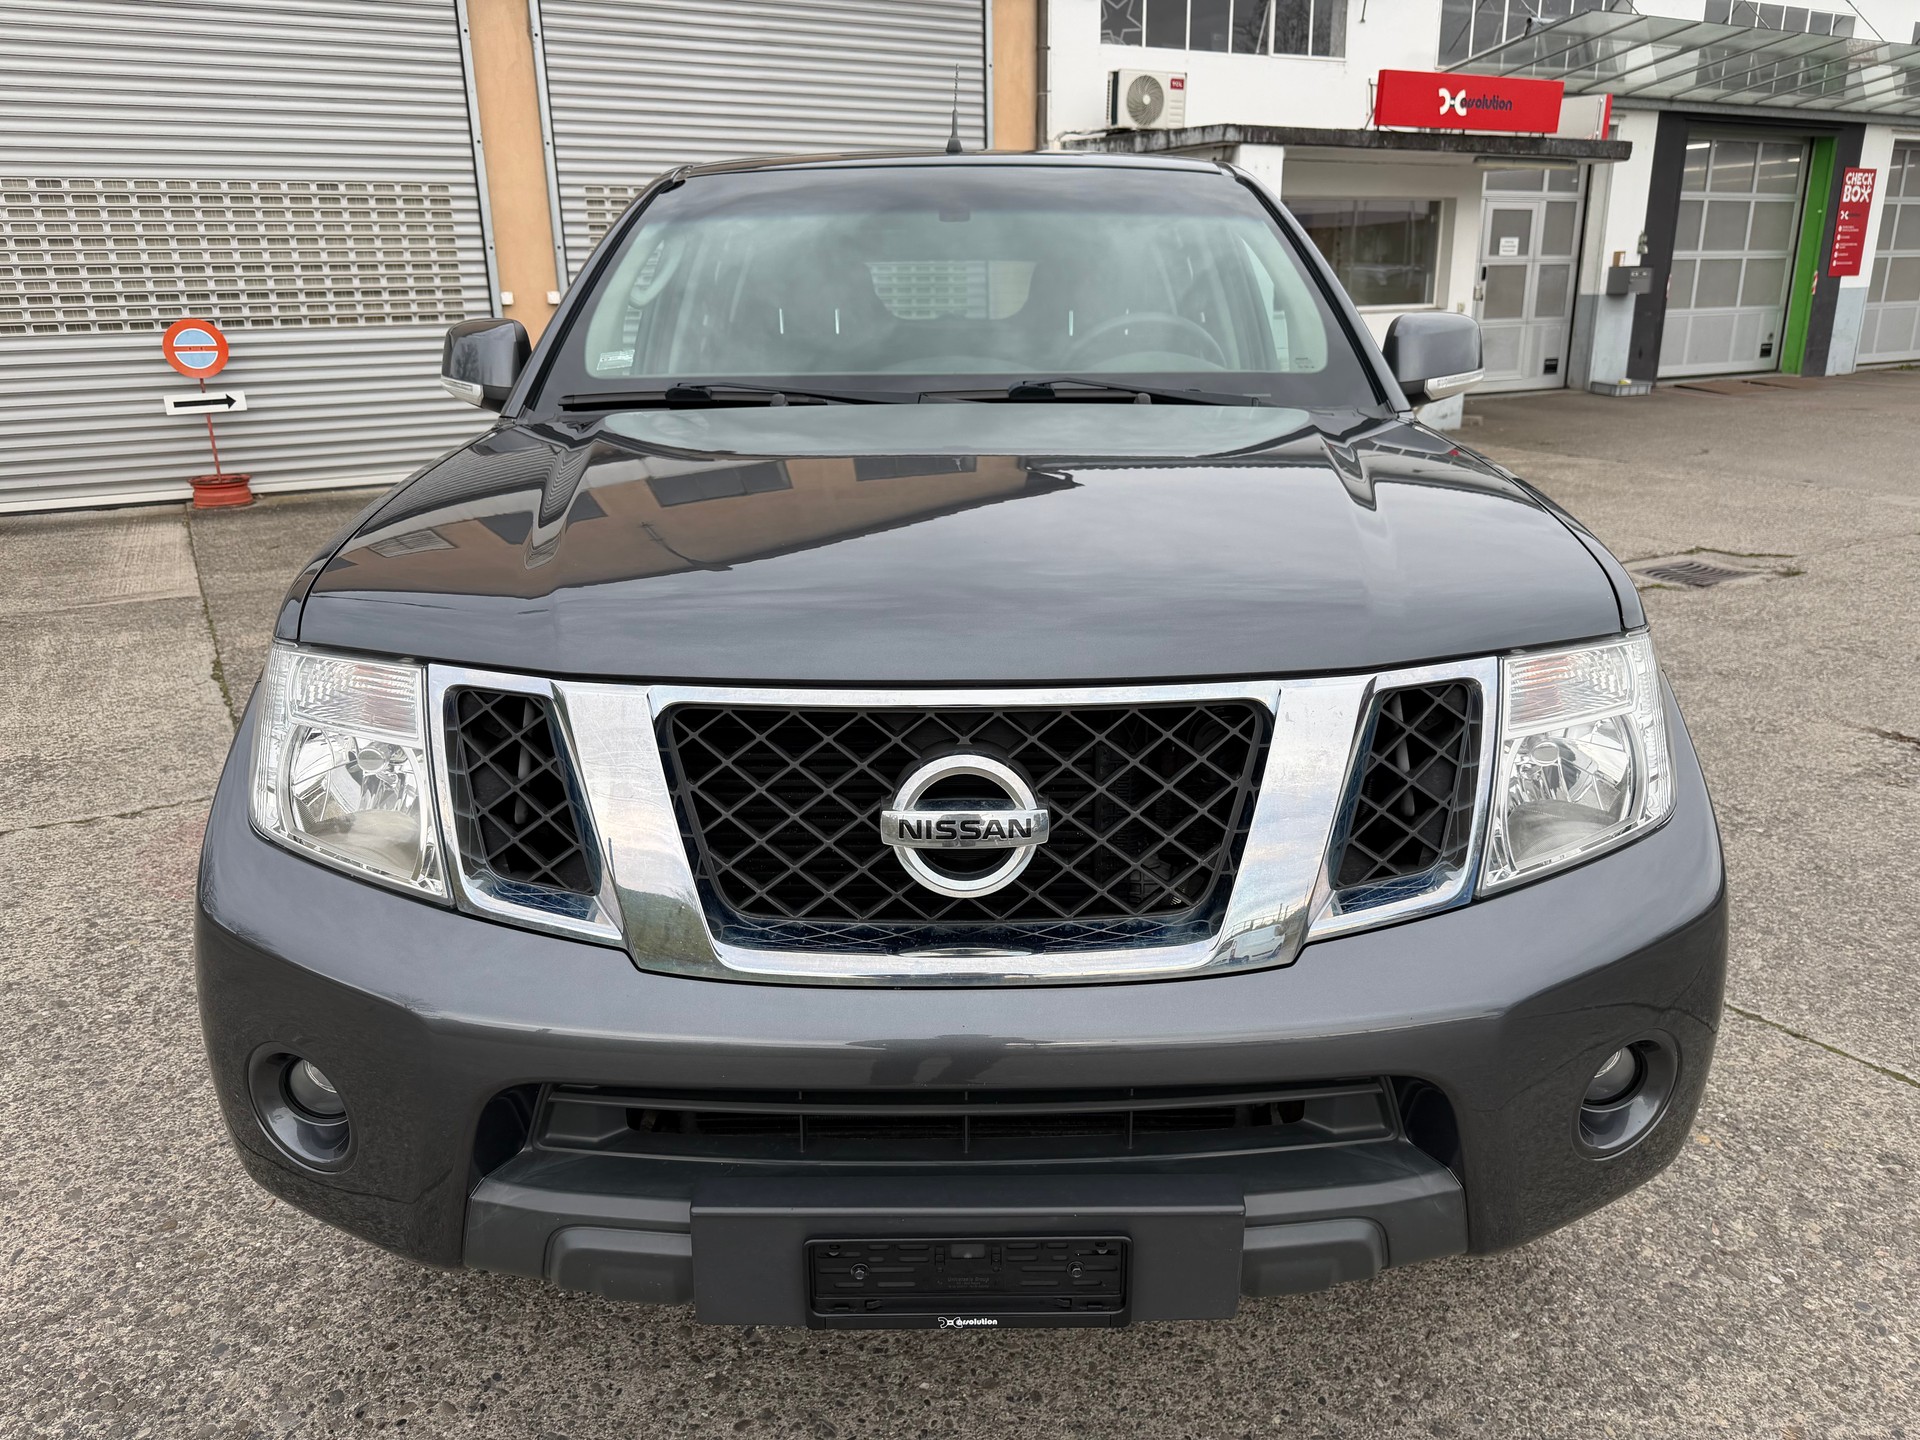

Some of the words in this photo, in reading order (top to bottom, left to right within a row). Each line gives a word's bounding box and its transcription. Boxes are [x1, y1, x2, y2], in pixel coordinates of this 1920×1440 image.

[1845, 172, 1874, 186] CHECK
[1842, 185, 1872, 203] BOX
[898, 818, 1032, 840] NISSAN
